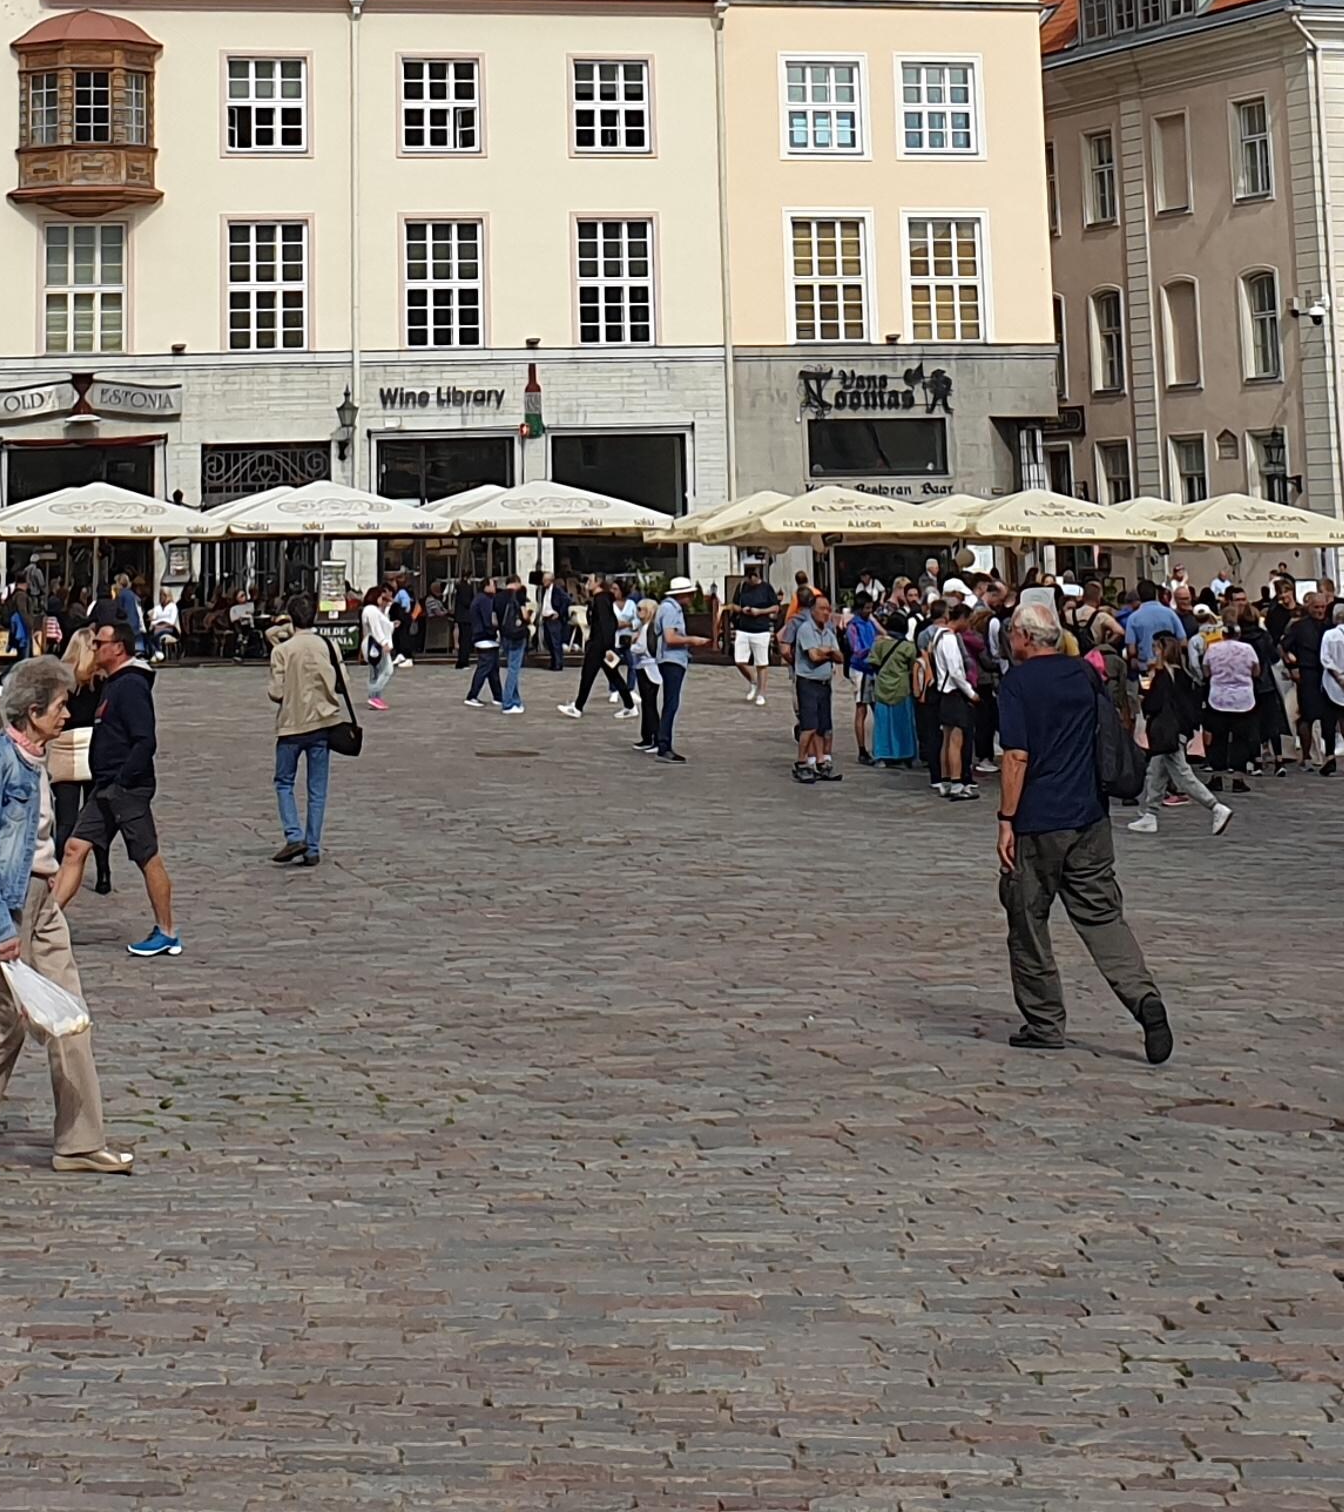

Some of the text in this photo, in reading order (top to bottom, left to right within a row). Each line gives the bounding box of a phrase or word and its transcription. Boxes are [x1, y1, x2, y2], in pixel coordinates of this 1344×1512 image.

[100, 387, 174, 410] ESTONIA
[379, 385, 505, 410] Wine Library
